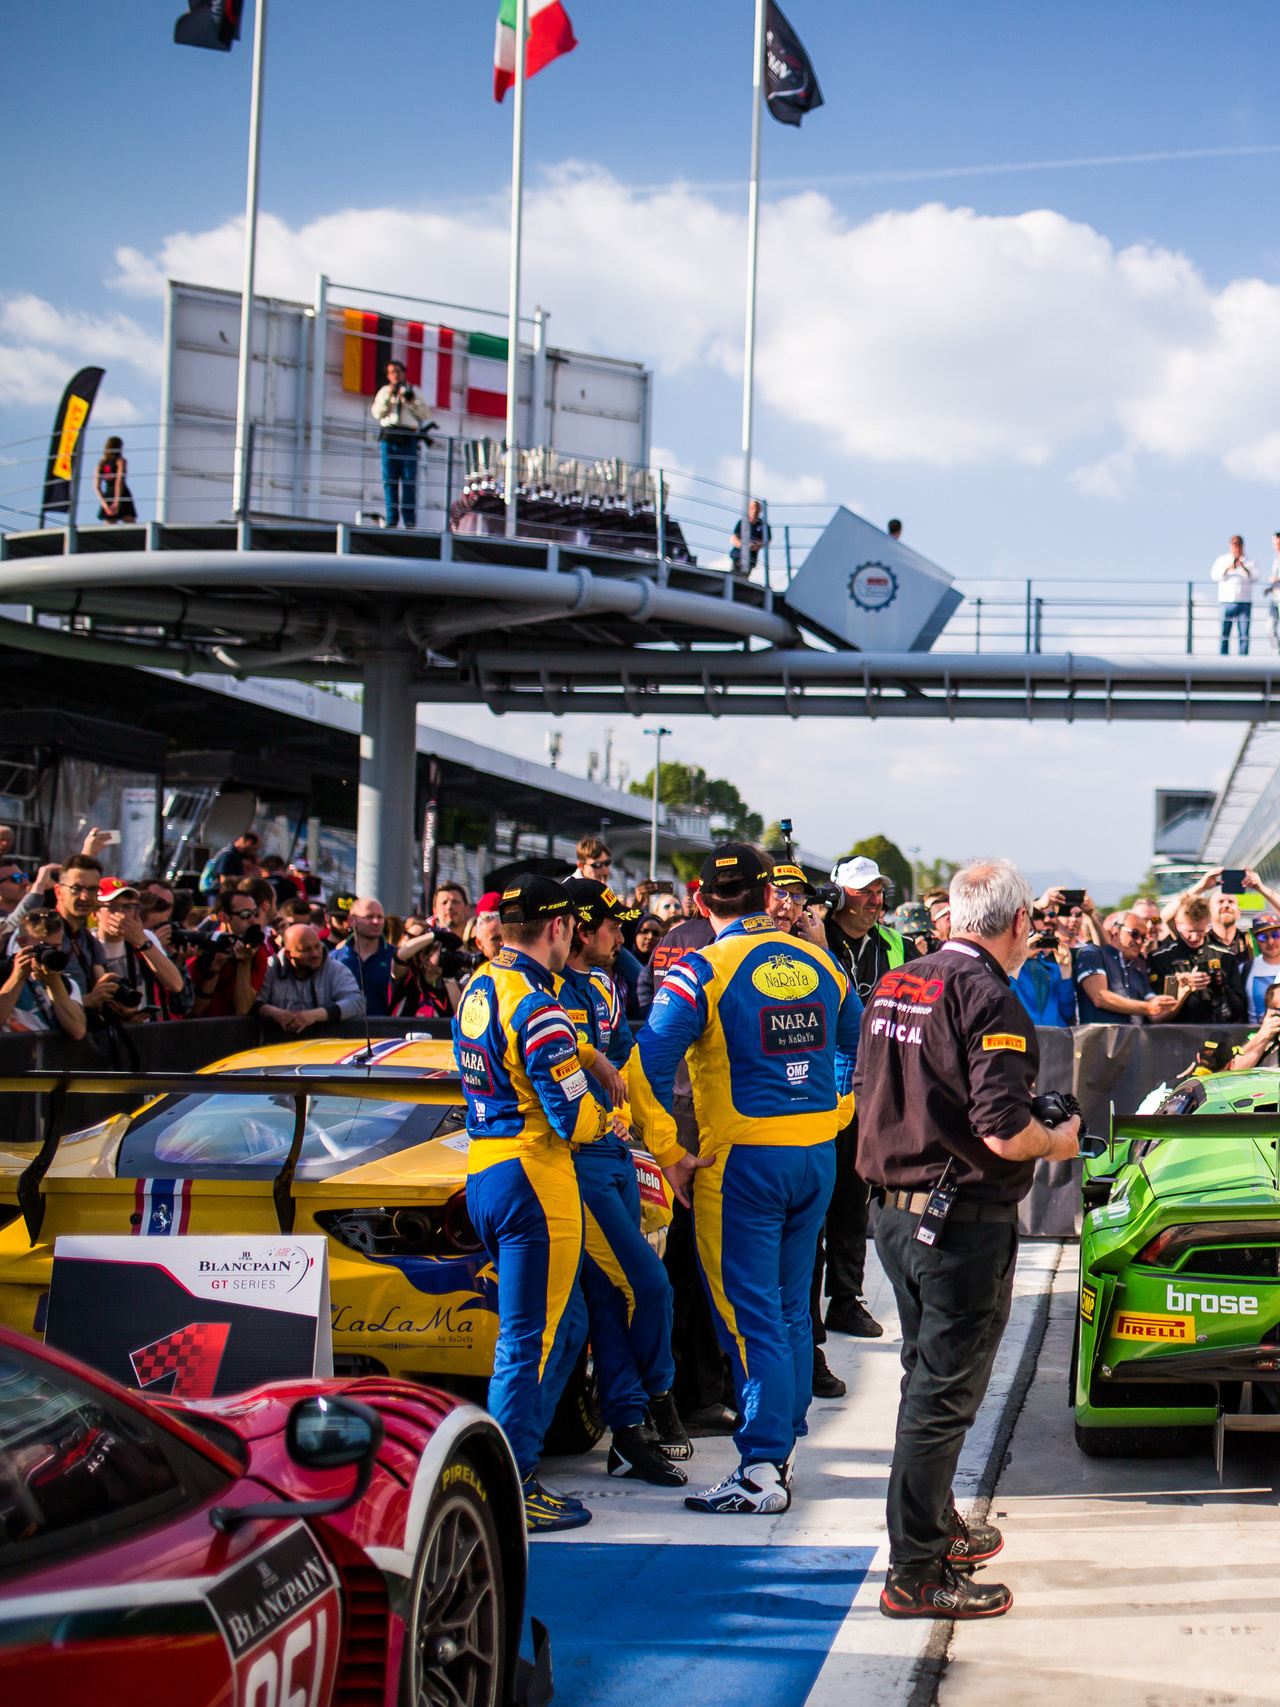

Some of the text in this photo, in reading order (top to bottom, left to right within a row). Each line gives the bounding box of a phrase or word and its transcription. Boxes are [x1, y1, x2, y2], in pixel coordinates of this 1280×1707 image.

[764, 970, 810, 989] NaRaYa
[875, 972, 945, 1004] SRO
[771, 1012, 819, 1031] NARA
[779, 1037, 786, 1045] by
[786, 1064, 809, 1078] OMP
[198, 1260, 292, 1272] BLANCPAIN
[211, 1279, 276, 1290] GT SERIES
[1081, 1293, 1095, 1315] OMP
[1166, 1284, 1258, 1315] brose
[1117, 1316, 1186, 1338] PIRELLI
[442, 1464, 488, 1502] PIRELLI
[228, 1556, 327, 1650] BLANCPAIN
